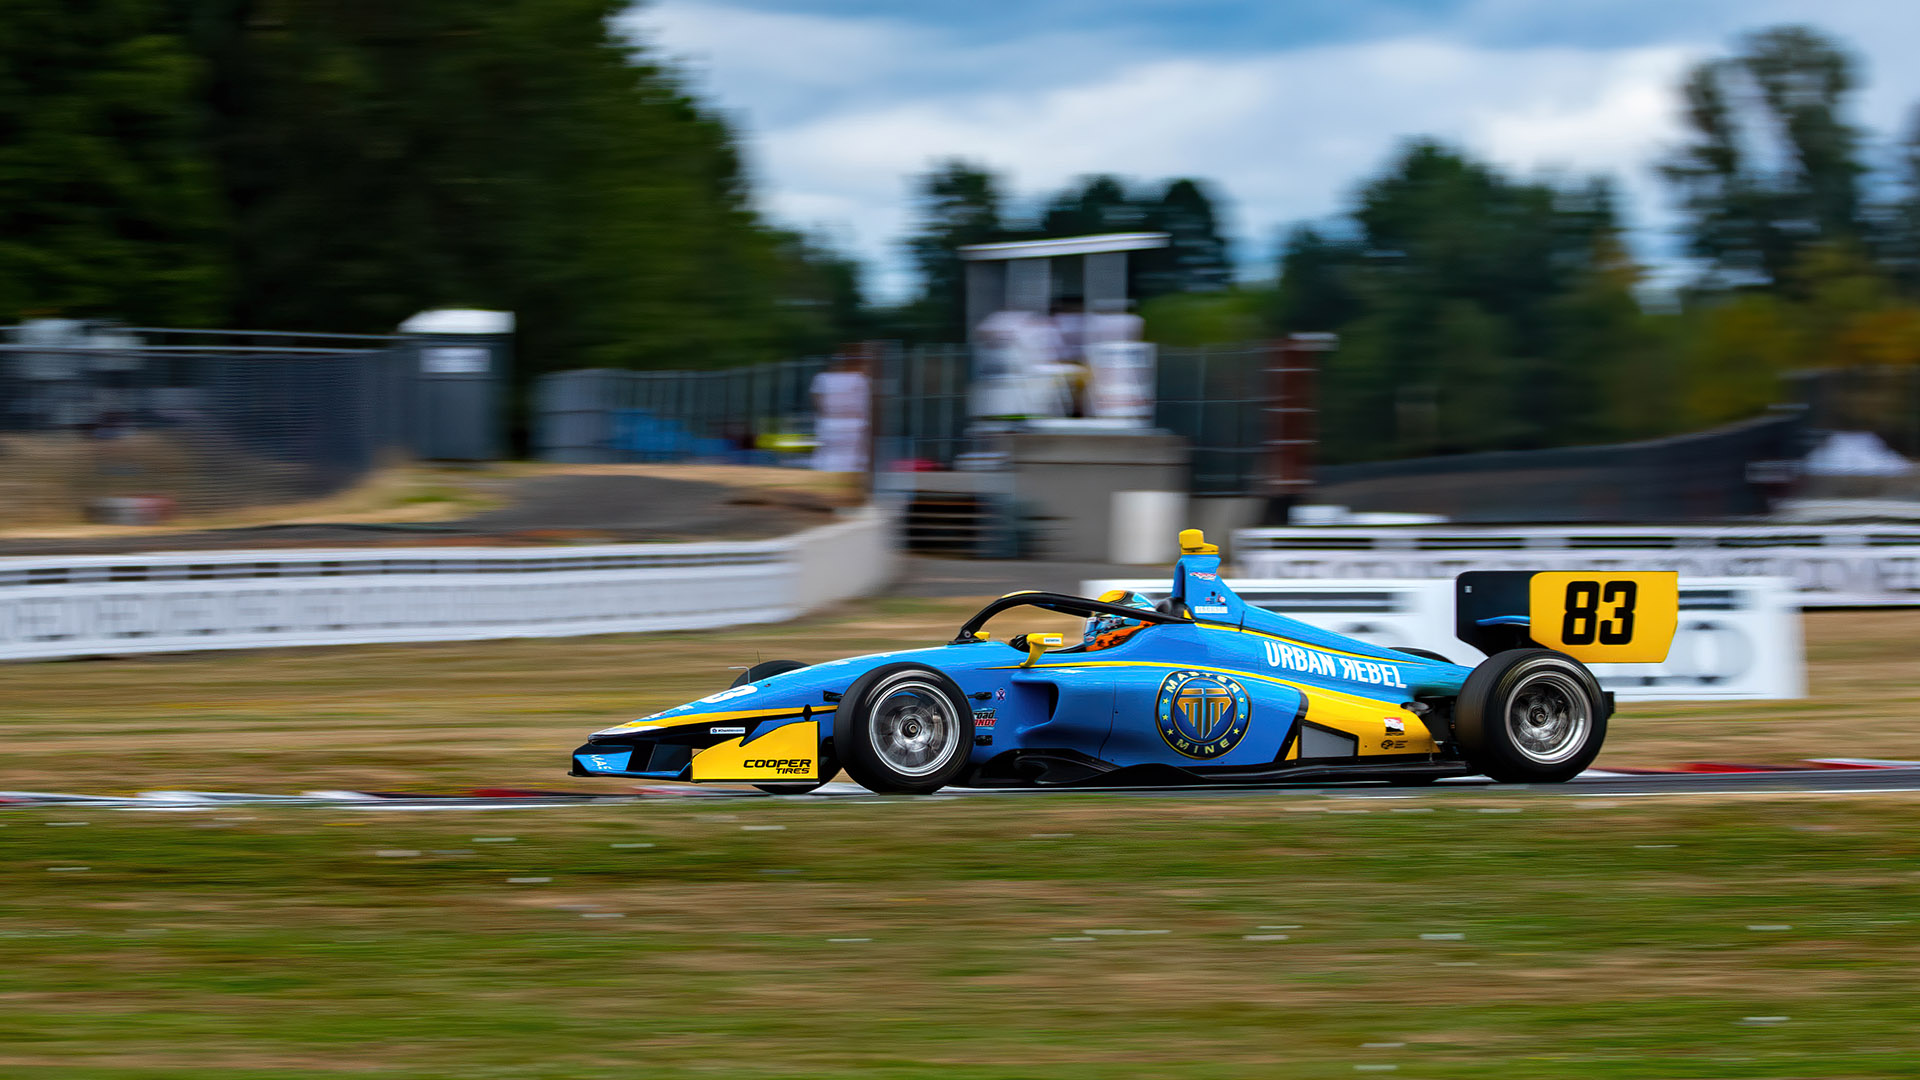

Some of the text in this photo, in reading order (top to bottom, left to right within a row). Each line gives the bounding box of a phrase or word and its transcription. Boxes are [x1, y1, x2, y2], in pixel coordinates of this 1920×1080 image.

[1562, 580, 1637, 646] 83
[1264, 640, 1336, 677] URBAN
[1165, 671, 1241, 693] MASTER
[1176, 738, 1230, 754] MINE
[743, 759, 812, 768] COOPER
[775, 767, 810, 775] TIRES
